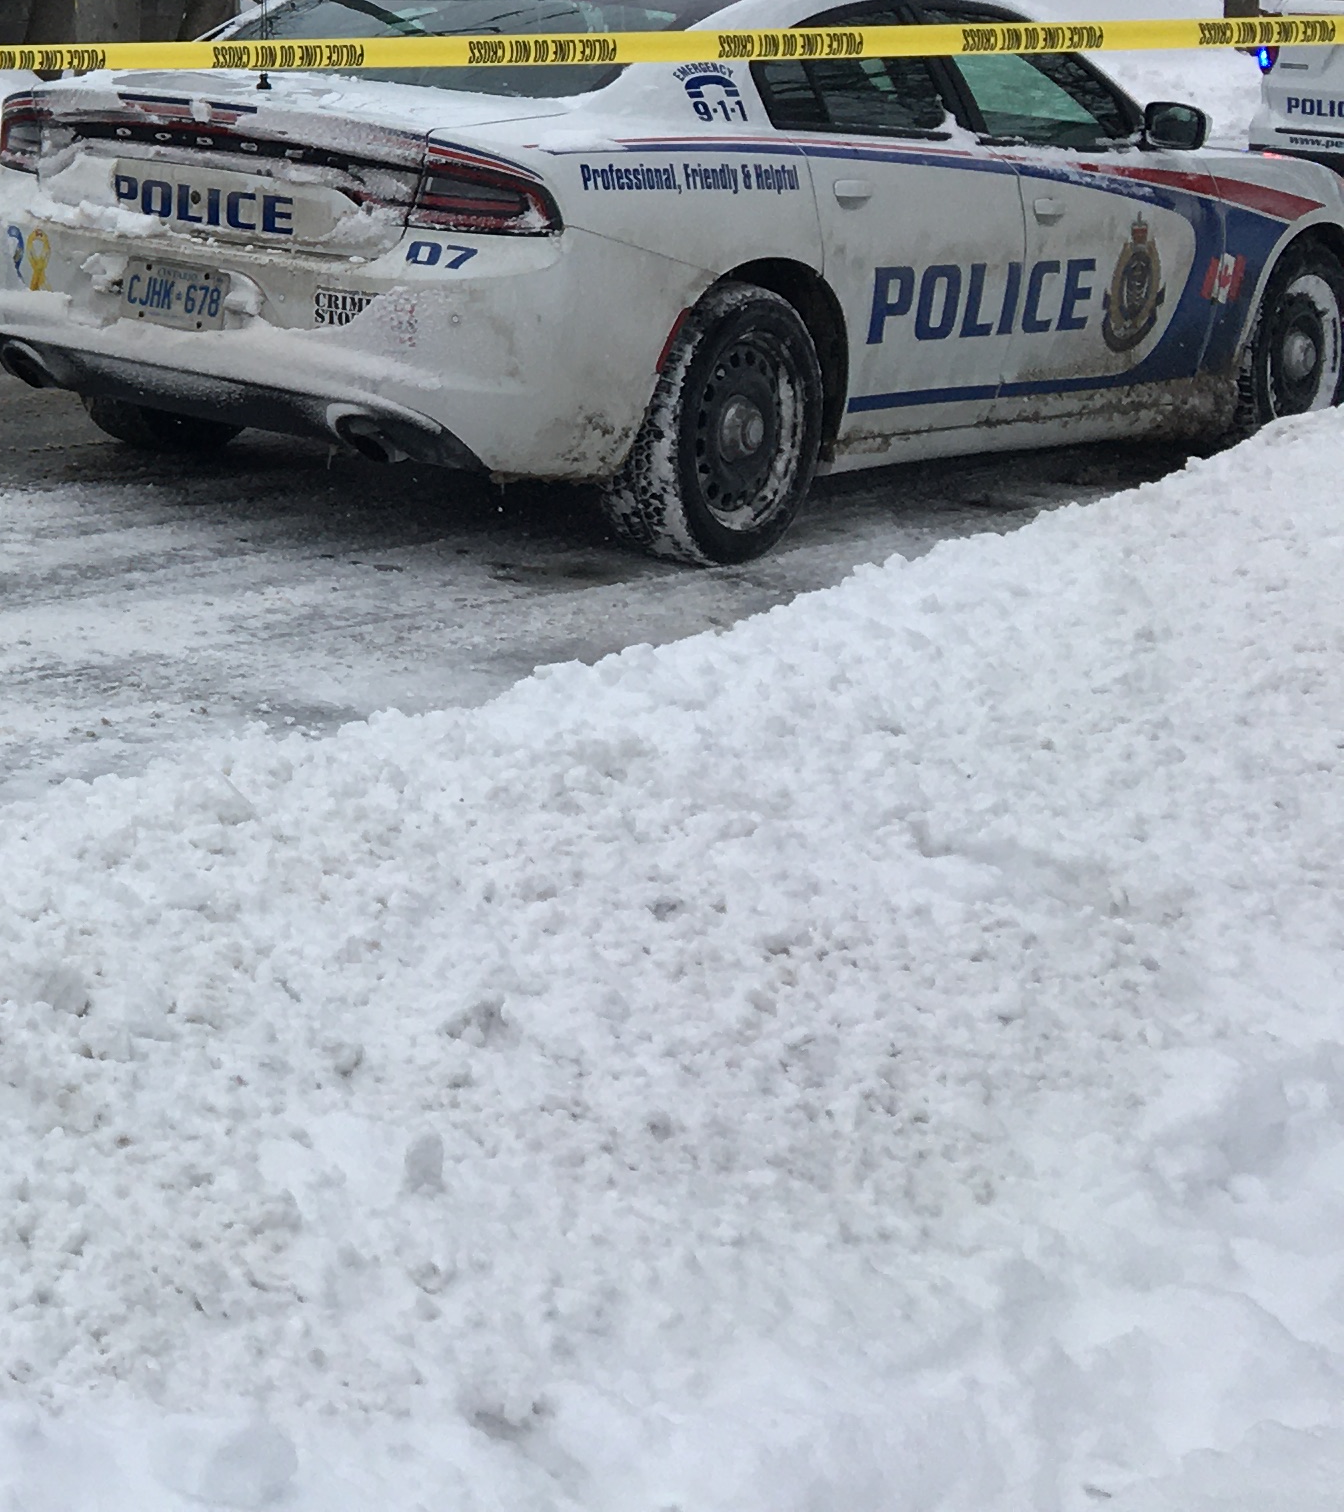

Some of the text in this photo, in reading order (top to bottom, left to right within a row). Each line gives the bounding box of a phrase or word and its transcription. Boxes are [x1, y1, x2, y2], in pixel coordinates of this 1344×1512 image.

[718, 32, 863, 58] POLICE LINE DO NOT CROSS
[962, 26, 1103, 51] POLICE LINE DO NOT CROSS
[1198, 20, 1335, 45] POLICE LINE DO NOT CROSS
[19, 50, 35, 70] DO
[38, 50, 63, 70] LINE
[66, 49, 105, 70] POLICE
[212, 44, 364, 68] POLICE LINE DO NOT CROSS
[468, 39, 617, 63] POLICE LINE DO NOT CROSS
[672, 62, 734, 82] EMERGENCY
[580, 163, 800, 195] Professional, Friendly & Helpful
[115, 173, 295, 236] POLICE
[406, 240, 479, 270] 07
[865, 258, 1097, 345] POLICE
